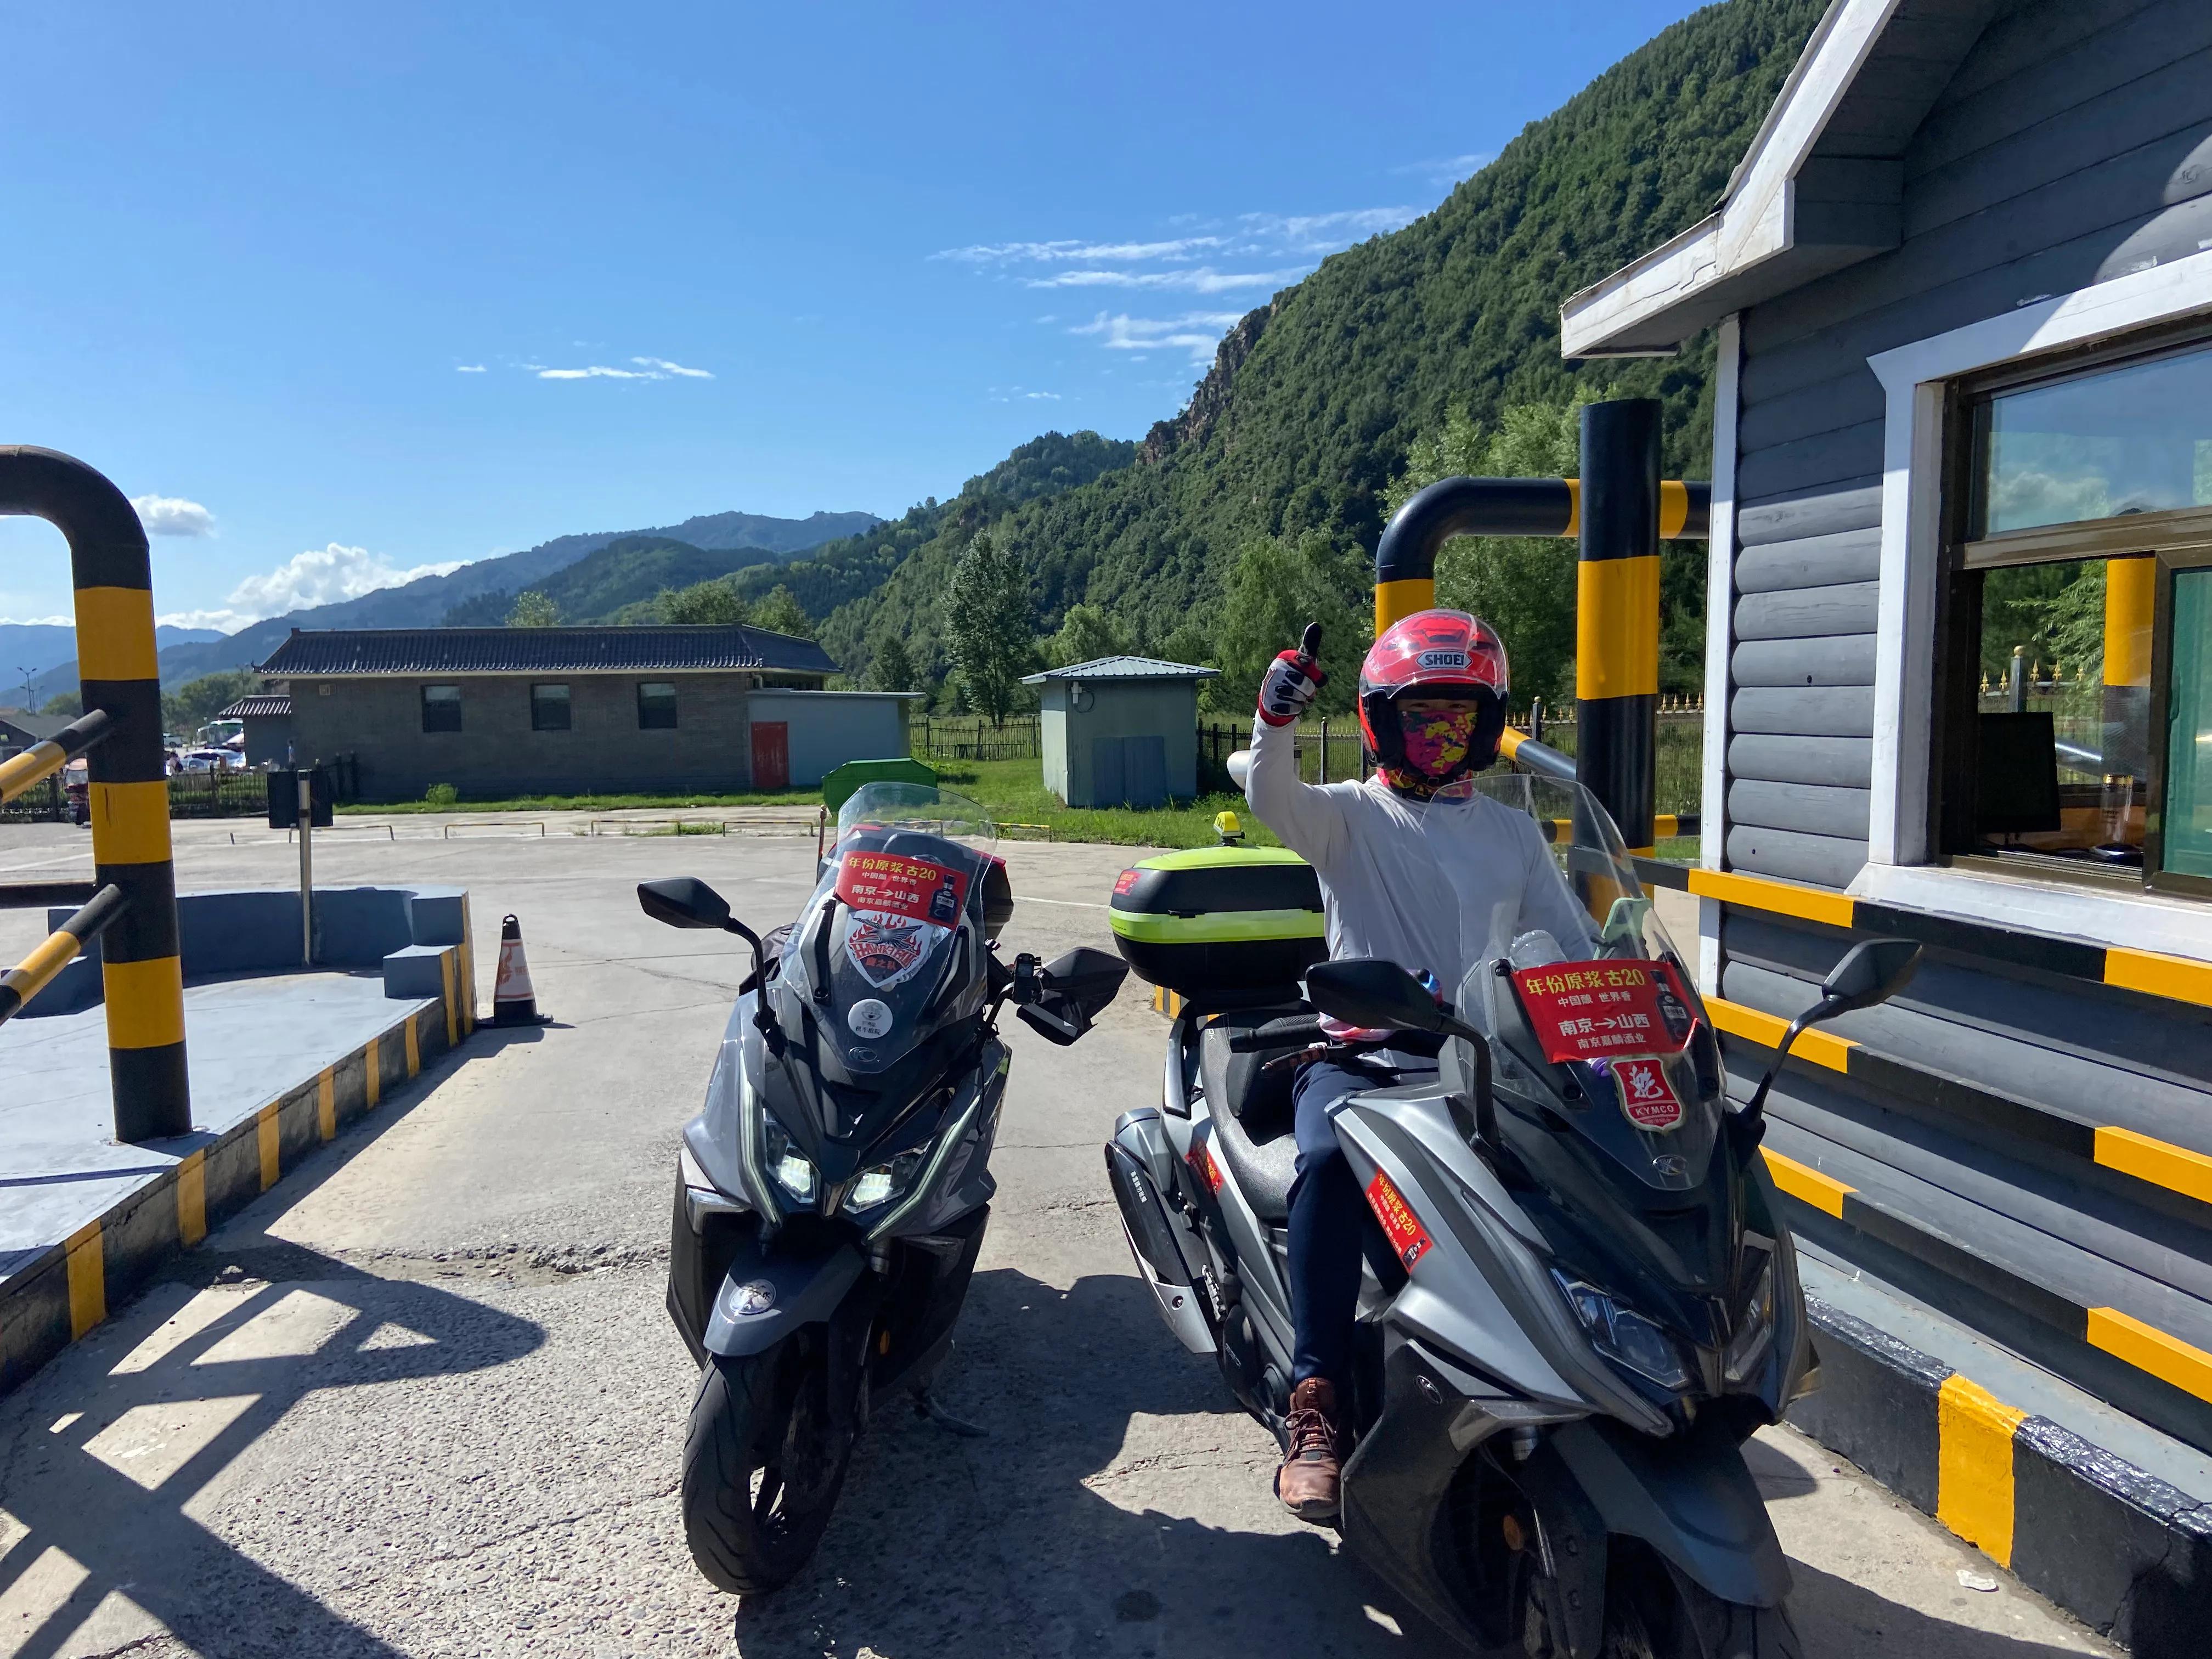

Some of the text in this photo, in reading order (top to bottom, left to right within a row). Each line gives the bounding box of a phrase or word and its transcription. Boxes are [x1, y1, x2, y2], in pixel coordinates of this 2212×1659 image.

[1425, 654, 1464, 665] SHOEI
[849, 857, 936, 881] 年份原浆 古20
[1526, 969, 1645, 996] 年份原浆 古20
[1635, 1105, 1674, 1115] KYMCO
[1398, 1210, 1416, 1235] 古20
